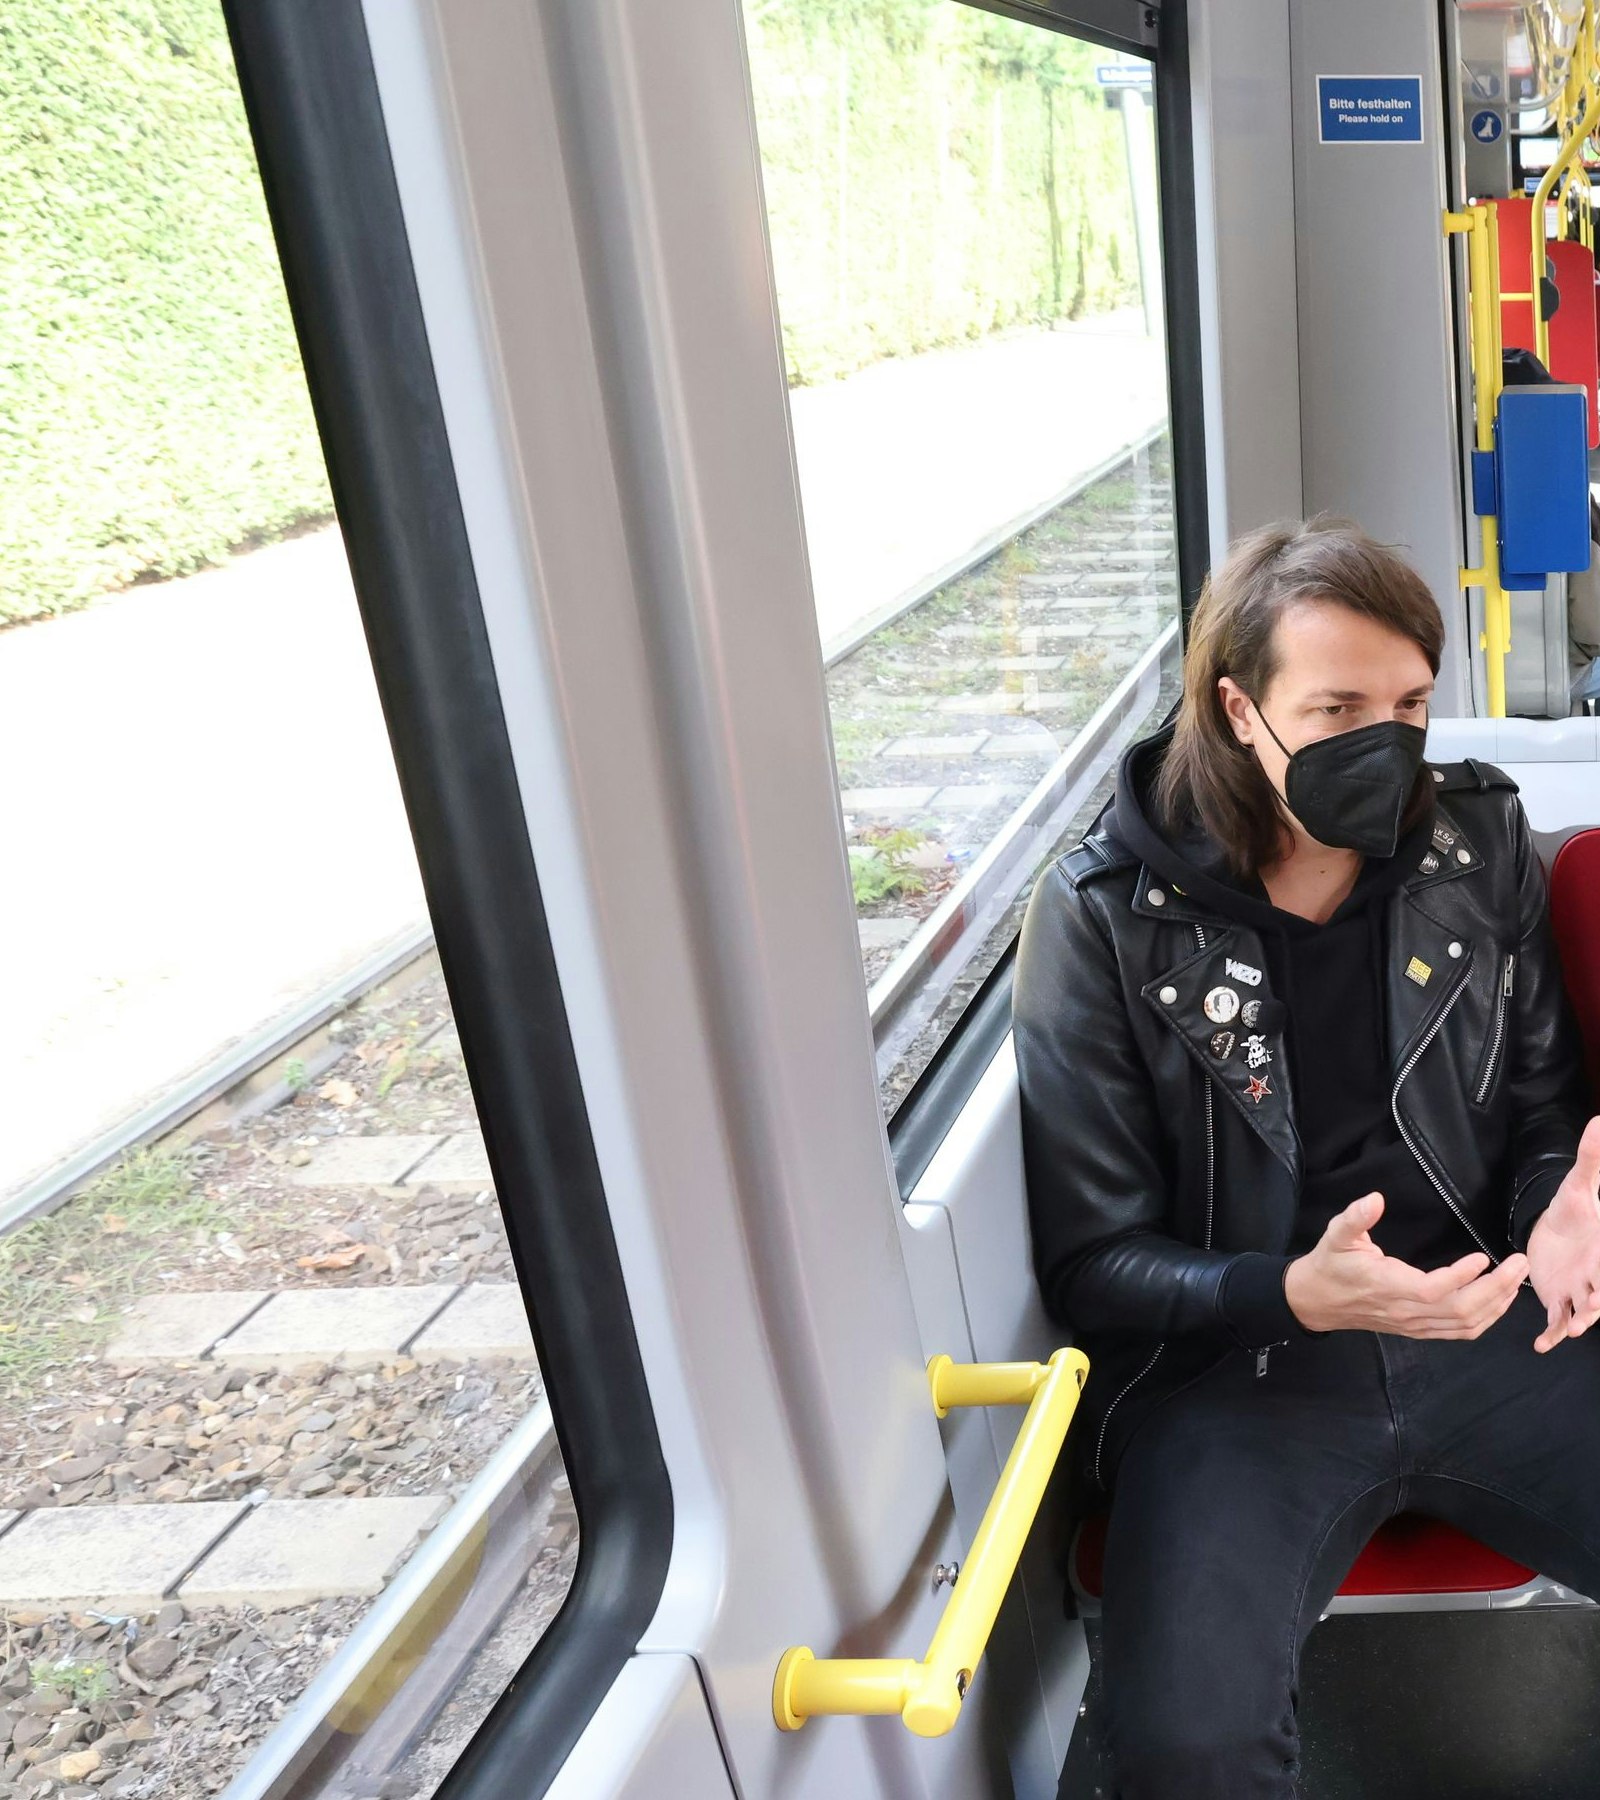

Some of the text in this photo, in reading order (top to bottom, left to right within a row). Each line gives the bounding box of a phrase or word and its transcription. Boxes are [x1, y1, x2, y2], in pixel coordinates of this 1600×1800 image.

[1329, 98, 1412, 110] Bitte festhalten
[1338, 114, 1404, 123] Please hold on
